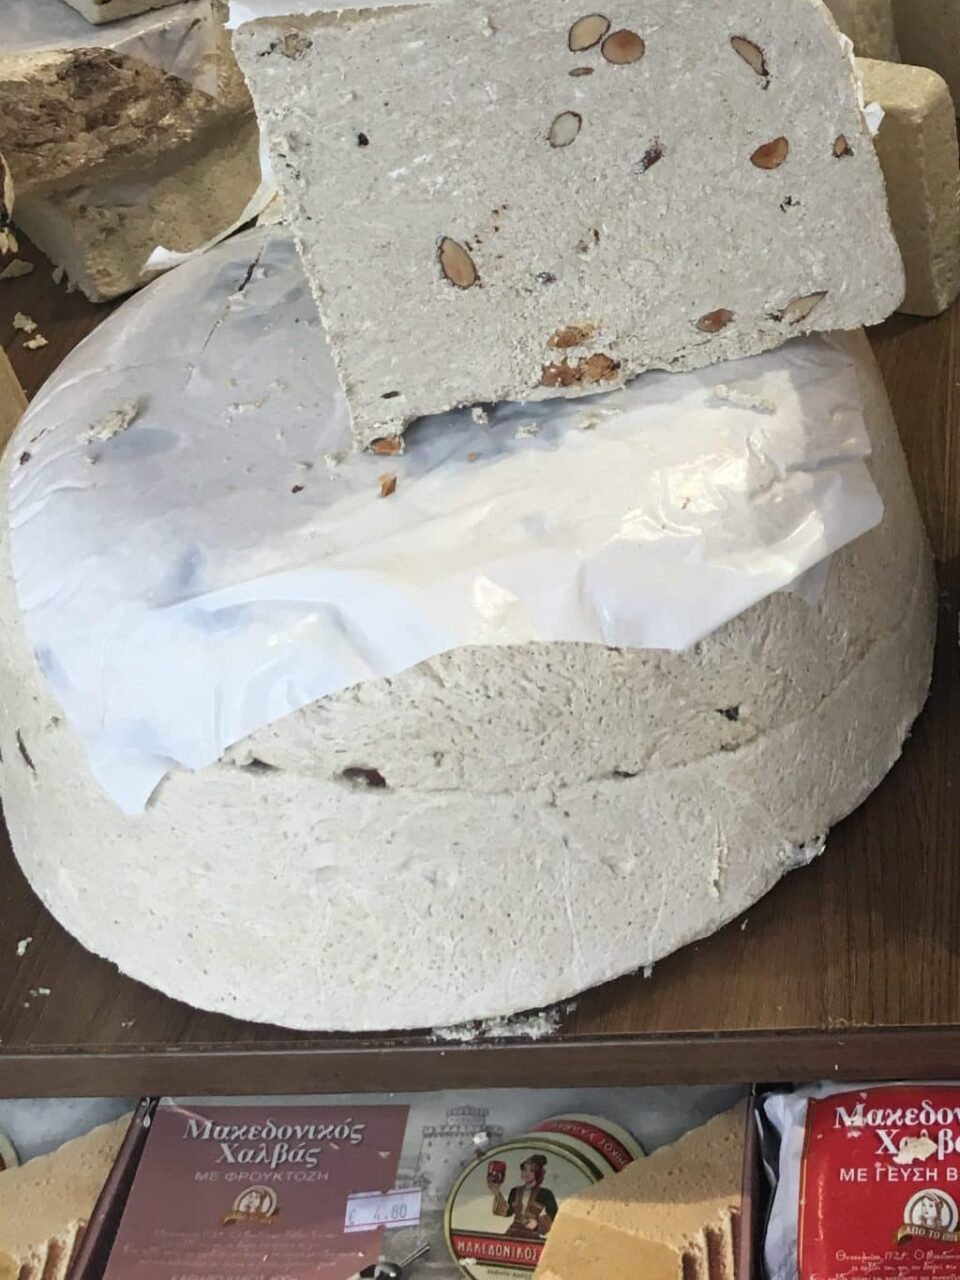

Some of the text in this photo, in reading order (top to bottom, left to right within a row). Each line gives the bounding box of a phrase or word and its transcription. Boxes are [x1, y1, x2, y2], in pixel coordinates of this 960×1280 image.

[182, 1117, 367, 1144] Μακεδονικός
[215, 1141, 322, 1168] Χαλβάς
[840, 1169, 868, 1182] ΜΕ
[876, 1166, 938, 1182] ΓΕΥΣΗ
